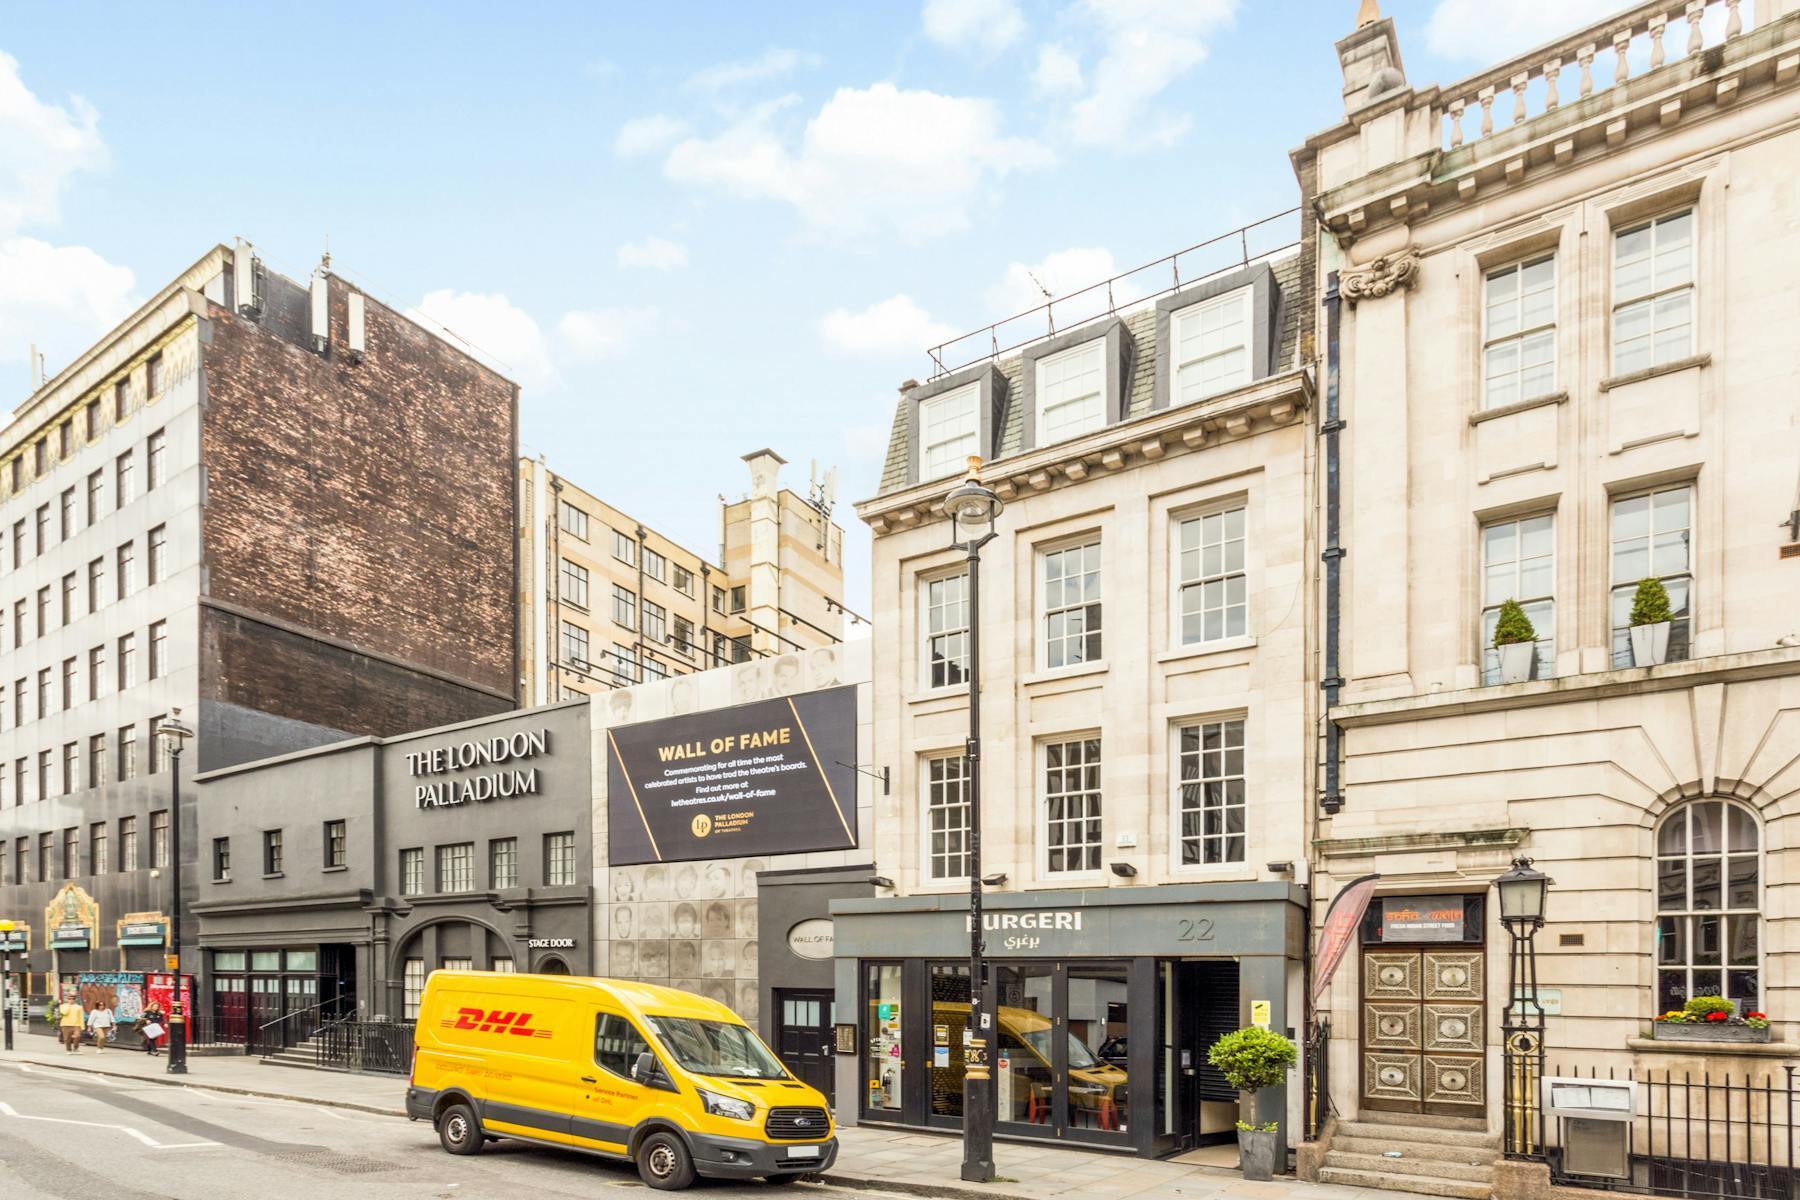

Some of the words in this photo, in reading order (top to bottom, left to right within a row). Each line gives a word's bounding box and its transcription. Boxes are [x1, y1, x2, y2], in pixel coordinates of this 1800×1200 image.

[406, 748, 444, 776] THE
[448, 729, 547, 770] LONDON
[658, 742, 706, 762] WALL
[710, 736, 735, 754] OF
[740, 727, 791, 750] FAME
[644, 777, 677, 789] celebrated
[678, 775, 697, 785] artists
[698, 774, 706, 782] to
[706, 772, 722, 781] have
[722, 770, 737, 779] trod
[738, 768, 750, 777] the
[750, 764, 780, 776] theatre's
[781, 761, 808, 771] boards.
[664, 762, 717, 777] Commemorating
[717, 761, 727, 769] for
[727, 759, 737, 768] all
[737, 757, 752, 767] time
[753, 755, 765, 765] the
[765, 753, 784, 763] most
[416, 768, 536, 808] PALLADIUM
[695, 786, 709, 794] Find
[710, 784, 722, 793] out
[722, 783, 740, 791] more
[740, 781, 749, 789] at
[714, 819, 749, 828] PALLADIUM
[727, 811, 754, 820] LONDON
[792, 935, 812, 943] WALL
[813, 935, 825, 943] OF
[1178, 918, 1215, 941] 22
[528, 938, 550, 948] STAGE
[550, 938, 574, 948] DOOR
[453, 1007, 537, 1038] DHL
